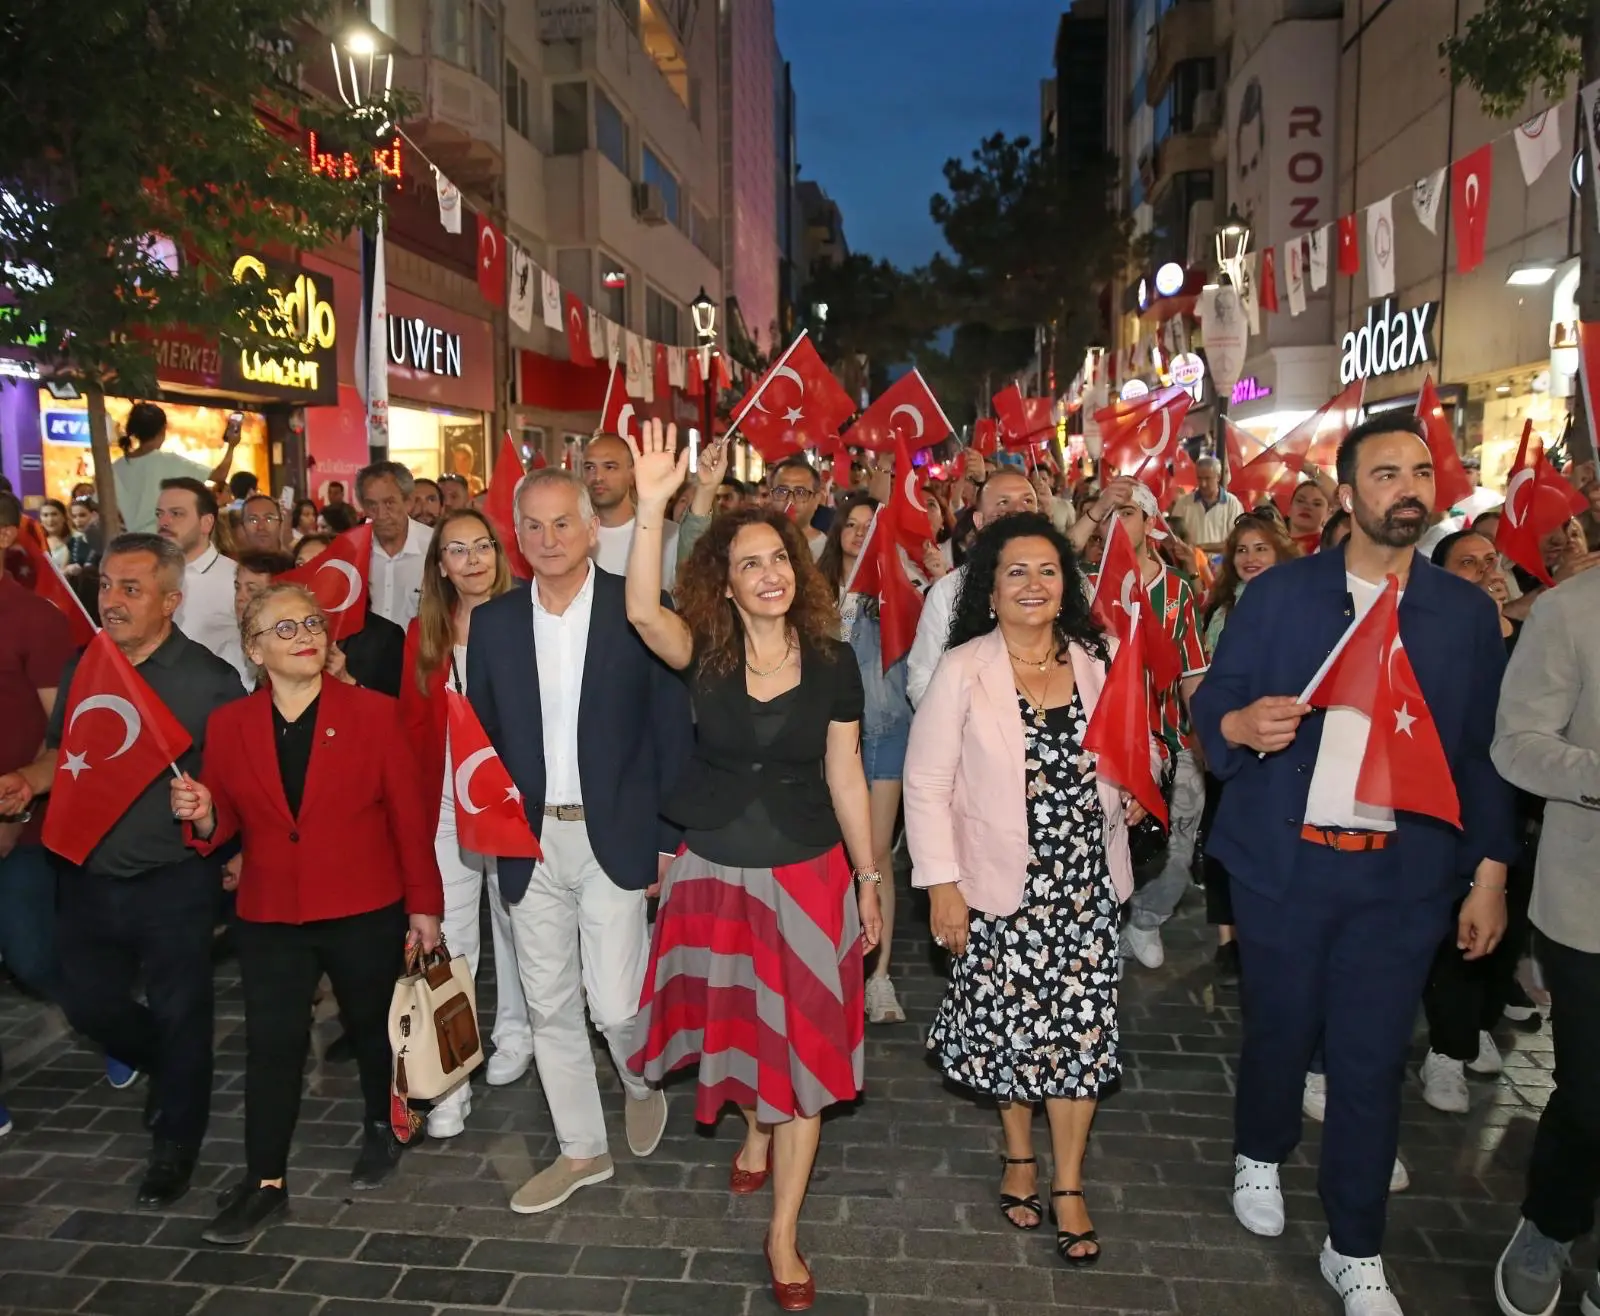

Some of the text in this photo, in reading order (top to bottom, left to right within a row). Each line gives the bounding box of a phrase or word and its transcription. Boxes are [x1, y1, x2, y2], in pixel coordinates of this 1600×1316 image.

[1288, 106, 1323, 272] ROZ
[389, 314, 461, 377] UWEN
[1340, 298, 1430, 385] addax
